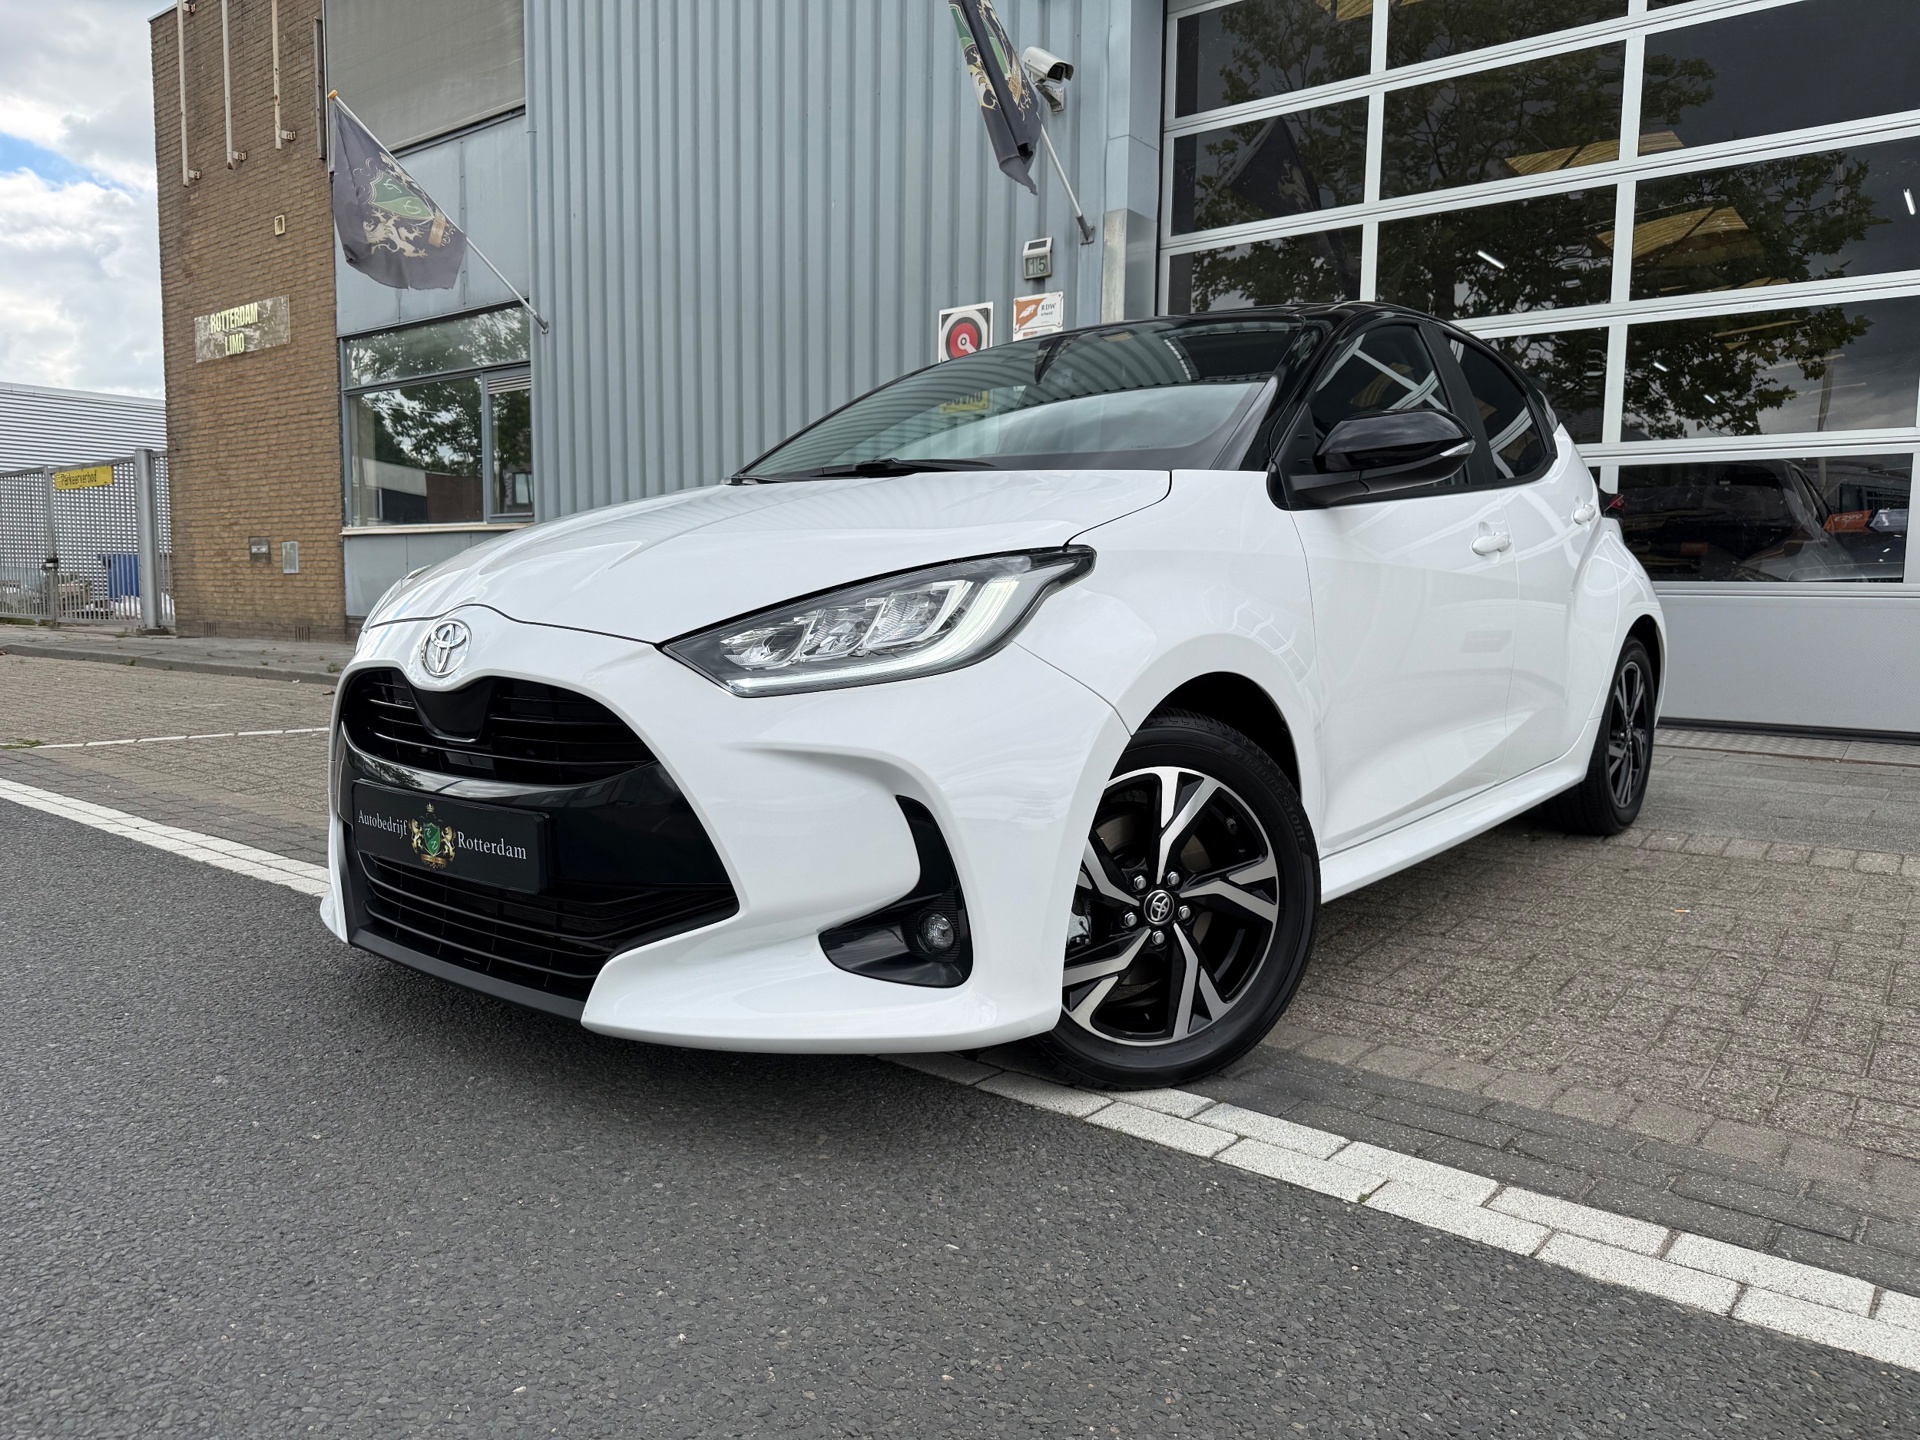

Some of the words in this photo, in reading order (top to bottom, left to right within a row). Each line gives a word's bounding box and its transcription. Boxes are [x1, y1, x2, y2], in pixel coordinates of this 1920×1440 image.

[210, 302, 259, 333] ROTTERDAM
[1041, 303, 1055, 311] RDW
[224, 333, 245, 355] LIMO
[358, 809, 408, 840] Autobedrijf
[457, 831, 527, 860] Rotterdam
